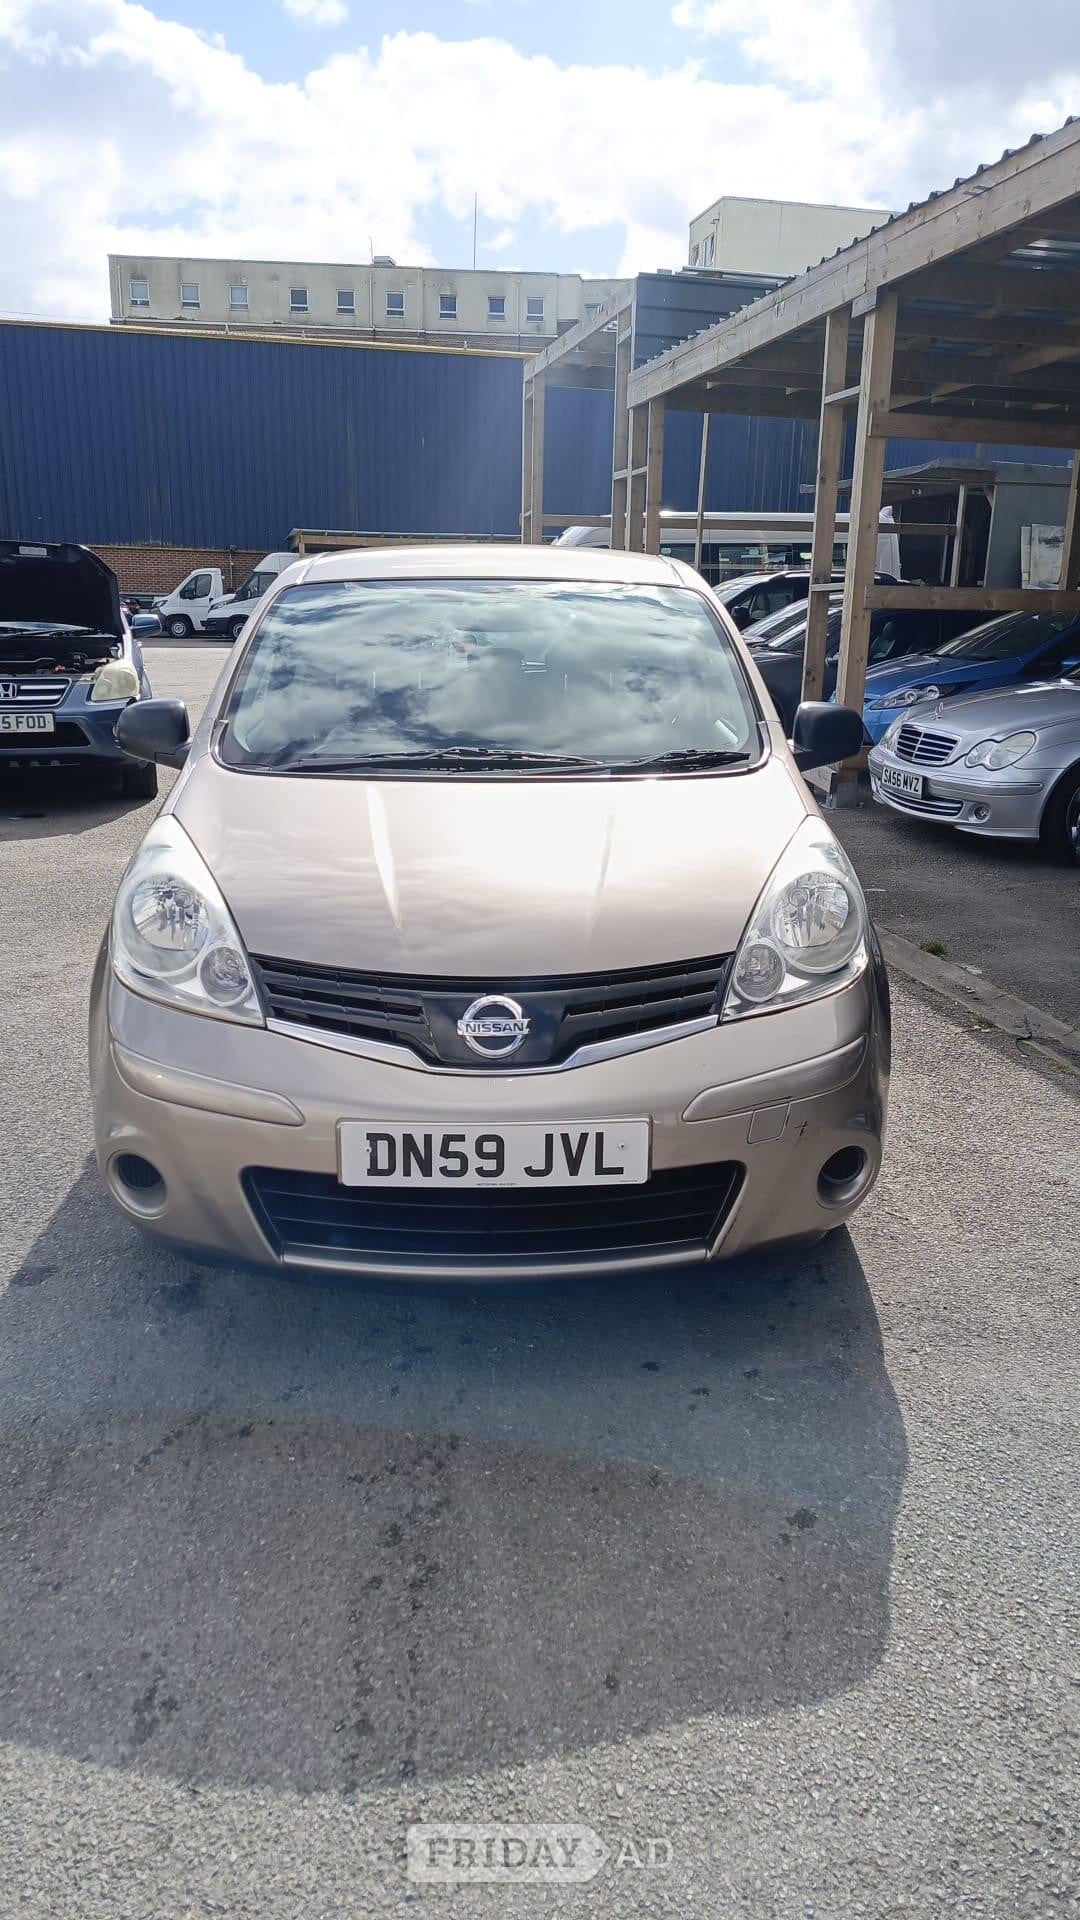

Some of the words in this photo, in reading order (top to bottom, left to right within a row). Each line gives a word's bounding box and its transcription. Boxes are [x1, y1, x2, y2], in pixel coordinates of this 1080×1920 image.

[884, 768, 901, 787] SA56
[902, 774, 920, 792] MVZ
[465, 1021, 524, 1033] NISSAN
[365, 1132, 506, 1178] DN59
[523, 1131, 625, 1177] JVL
